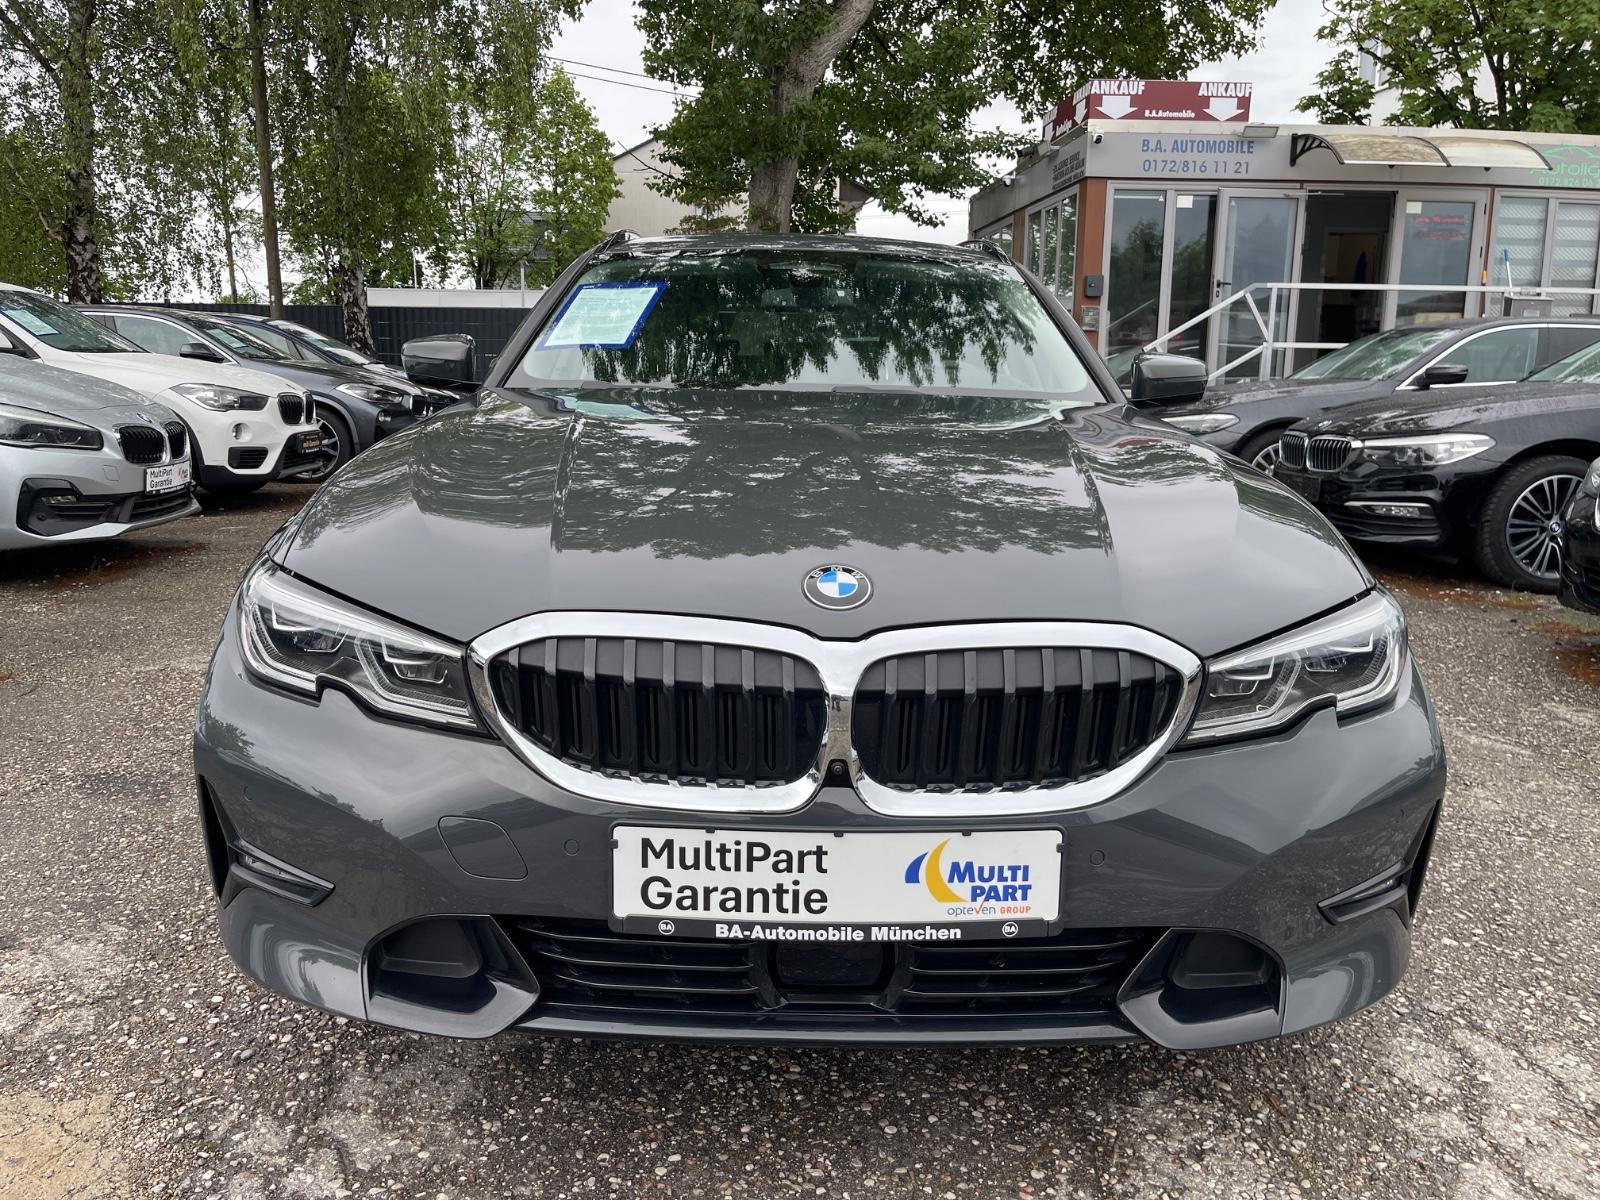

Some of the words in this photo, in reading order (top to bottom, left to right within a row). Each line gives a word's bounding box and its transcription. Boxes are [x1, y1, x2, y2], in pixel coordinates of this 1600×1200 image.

[1090, 80, 1145, 95] ANKAUF
[1198, 82, 1252, 97] ANKAUF
[1144, 109, 1195, 119] B.A.Automobile
[1141, 139, 1167, 153] B.A.
[1171, 139, 1255, 154] AUTOMOBILE
[1142, 159, 1208, 174] 0172/816
[1214, 160, 1227, 173] 11
[1234, 161, 1249, 174] 21
[641, 837, 828, 874] MultiPart
[640, 875, 828, 915] Garantie
[970, 884, 1033, 902] PART
[947, 899, 996, 917] opteven
[1000, 905, 1031, 915] GROUP
[715, 924, 864, 941] BA-Automobile
[870, 926, 961, 941] München
